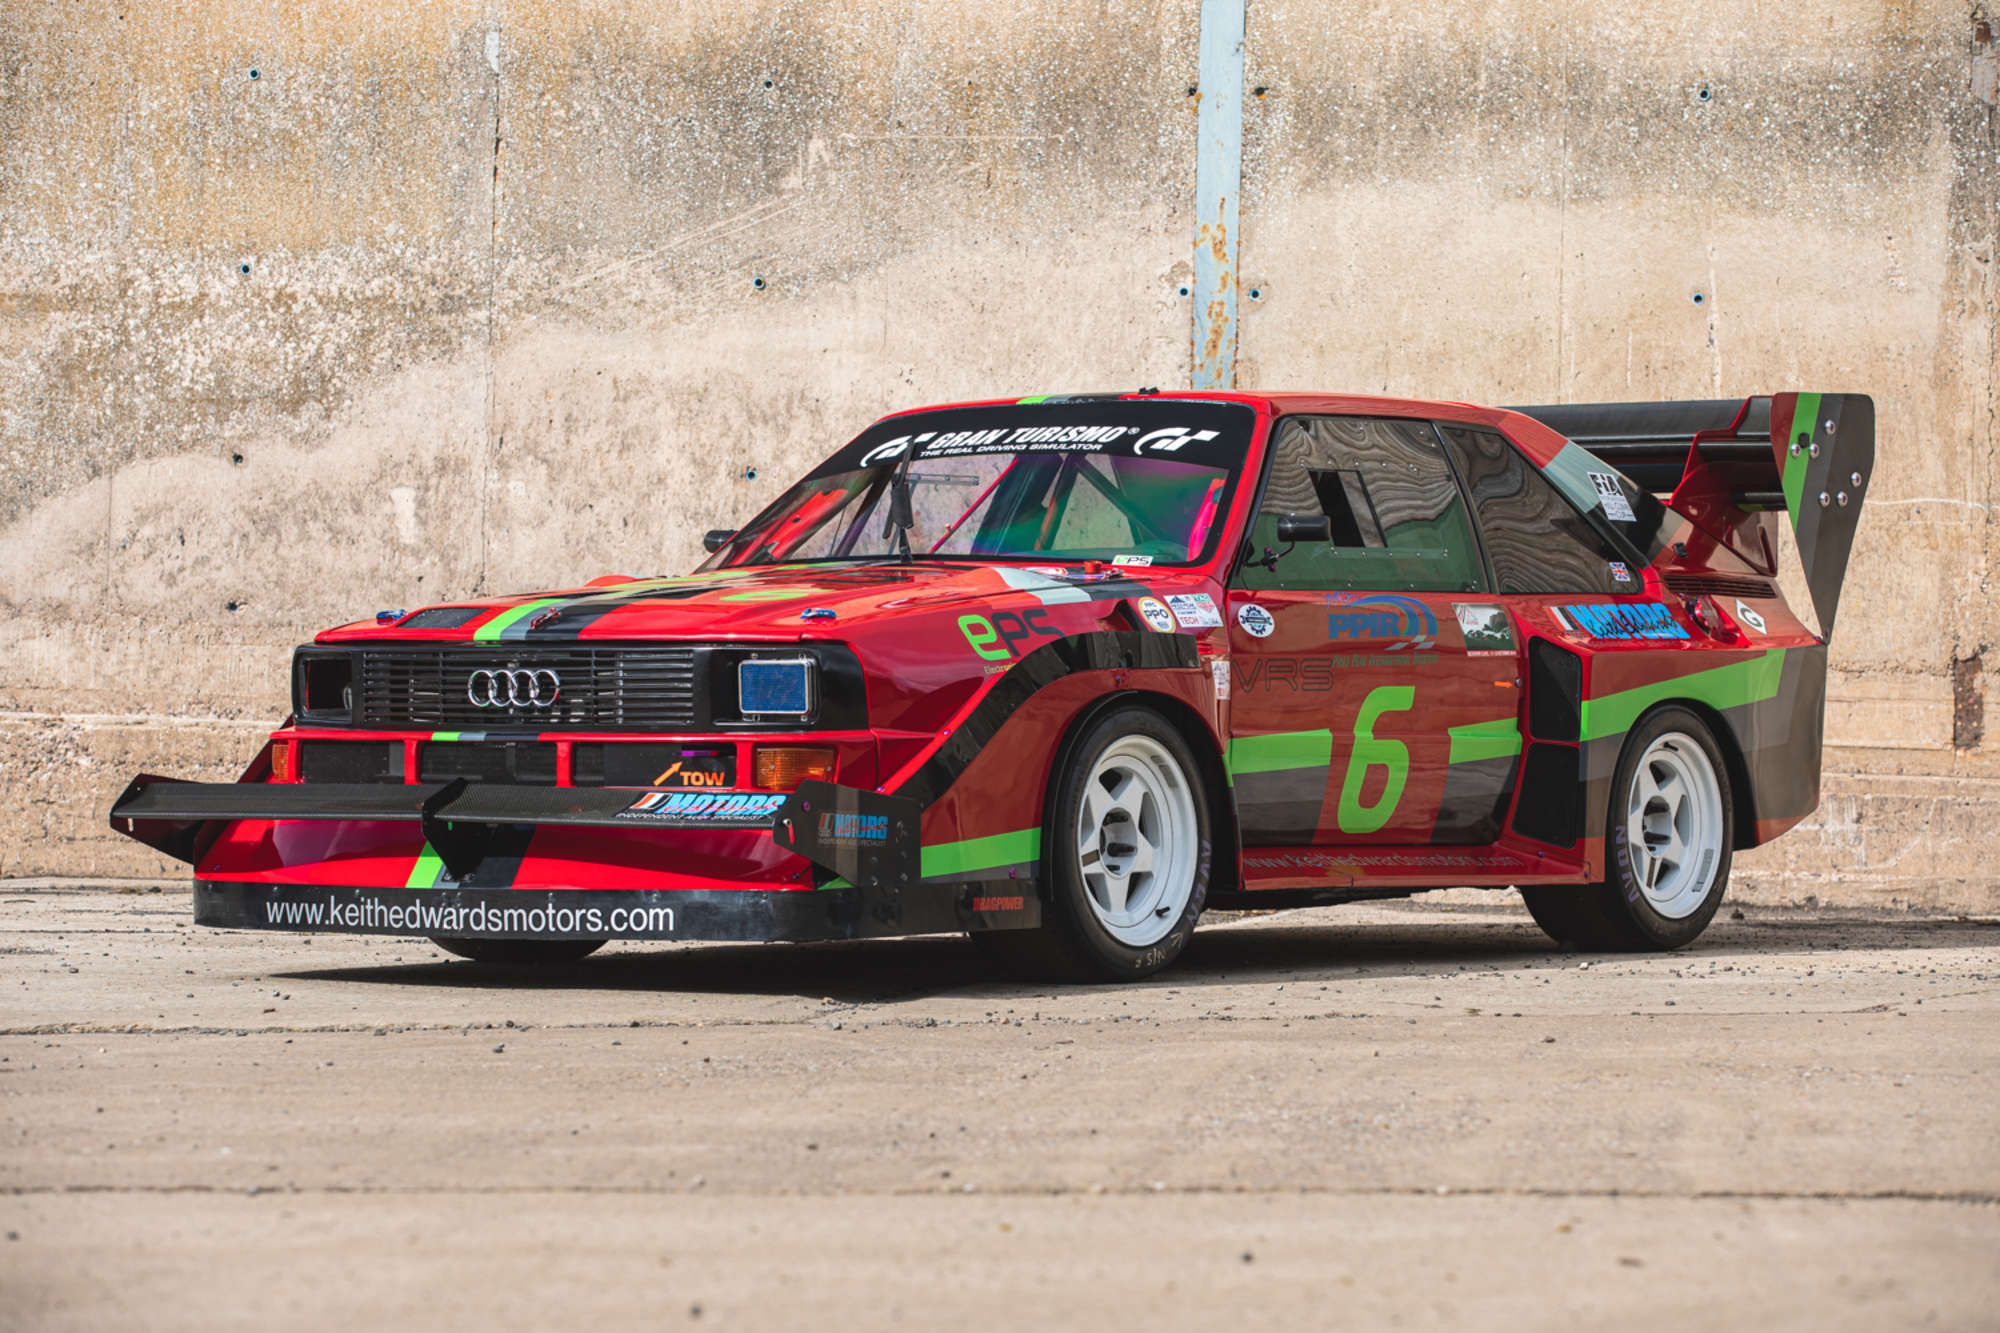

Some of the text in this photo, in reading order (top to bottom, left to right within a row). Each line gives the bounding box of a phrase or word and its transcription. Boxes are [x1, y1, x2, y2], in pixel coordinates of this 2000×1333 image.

[926, 428, 1010, 450] GRAN
[920, 443, 1103, 458] THE REAL DRIVING SIMULATOR
[1144, 609, 1169, 619] PPO
[1180, 616, 1199, 625] TECH
[1740, 608, 1763, 627] G
[1328, 613, 1401, 639] PPIR
[1230, 657, 1335, 693] VRS
[1337, 685, 1415, 834] 6
[680, 771, 725, 786] TOW
[654, 793, 788, 816] MOTORS
[266, 894, 675, 936] www.keithedwardsmotors.com
